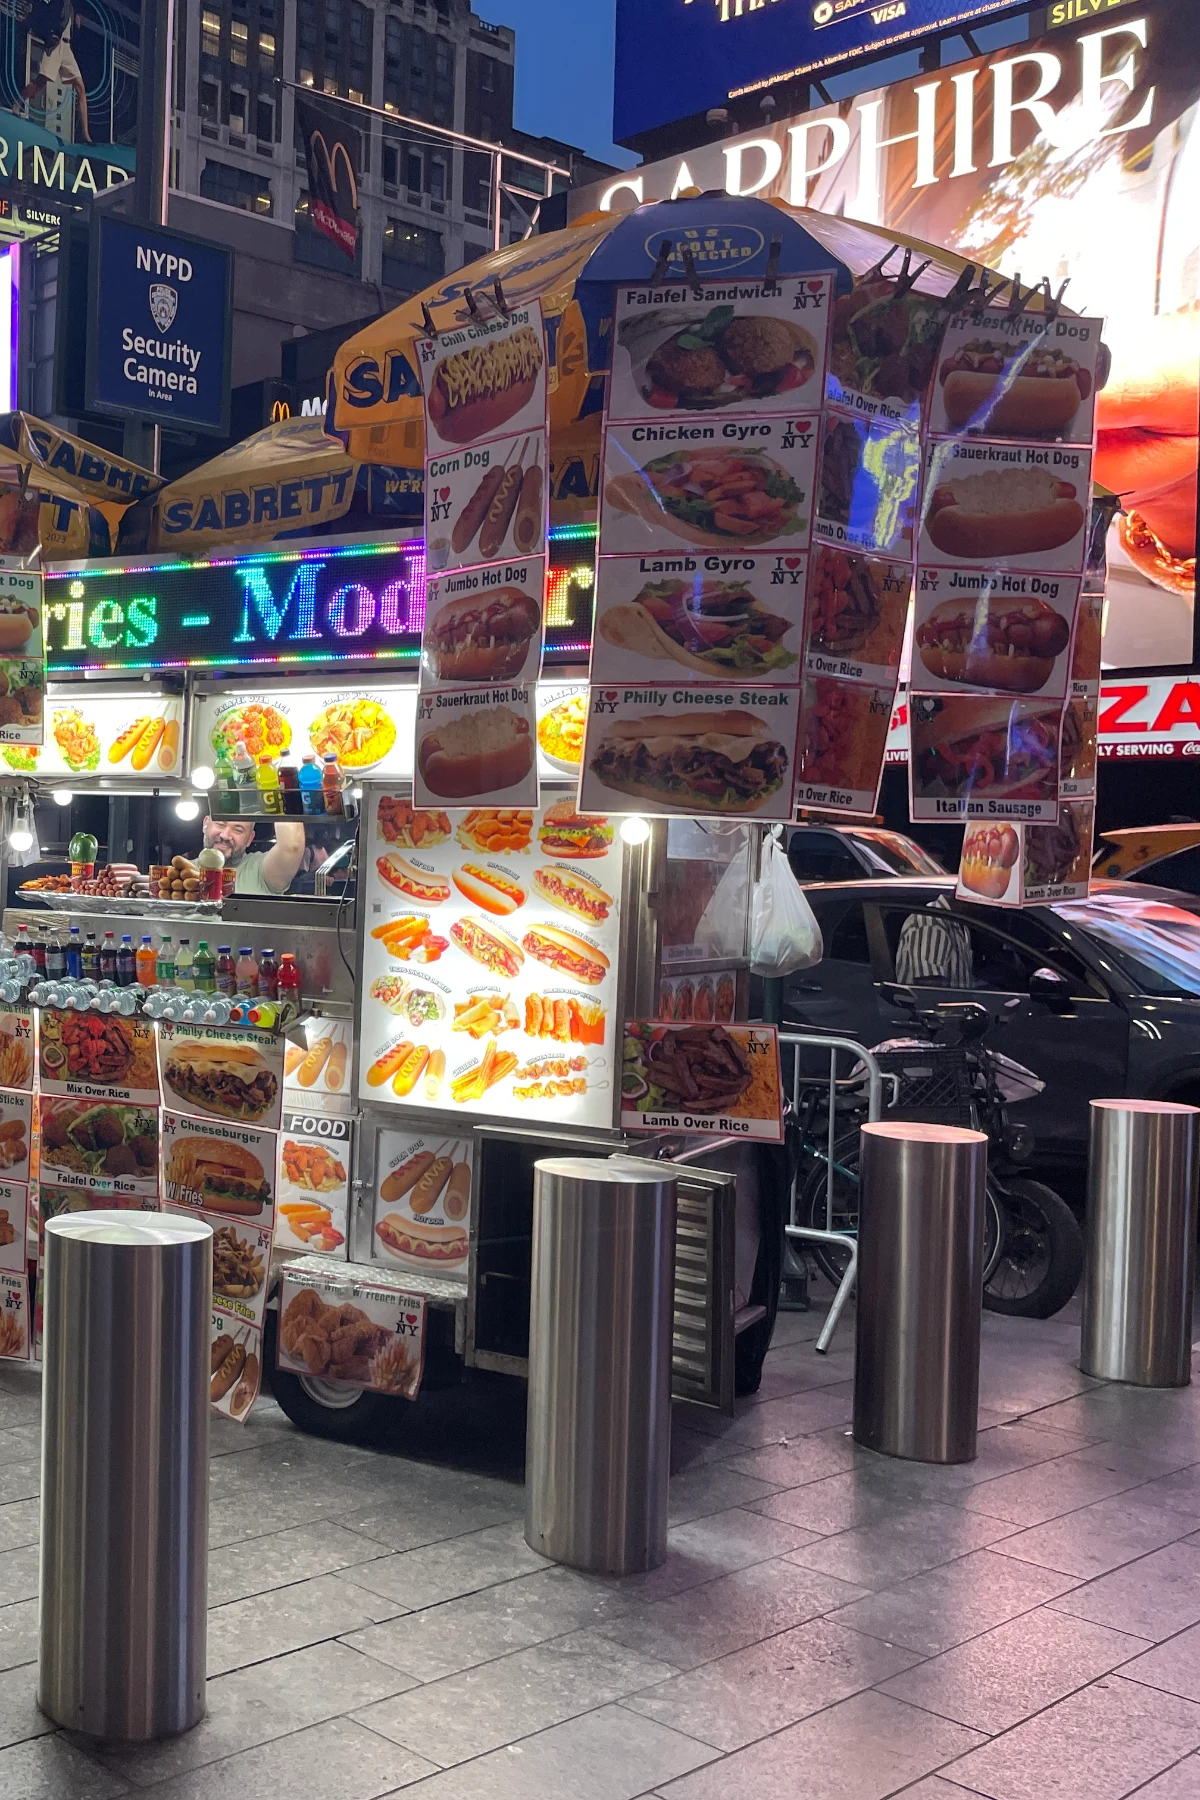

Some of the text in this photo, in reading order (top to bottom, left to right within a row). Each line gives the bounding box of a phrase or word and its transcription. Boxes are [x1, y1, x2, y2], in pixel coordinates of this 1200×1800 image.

[871, 2, 906, 25] VISA
[864, 39, 886, 52] Subject
[893, 32, 910, 42] credit
[939, 17, 957, 27] Learn
[957, 11, 974, 20] more
[136, 246, 193, 281] NYPD
[626, 283, 783, 305] Falafel Sandwich
[441, 310, 530, 349] Chili Cheese Dog
[1023, 316, 1050, 336] Hot
[1055, 323, 1090, 341] Dog
[122, 328, 201, 372] Security
[124, 358, 197, 394] Camera
[148, 388, 173, 401] In Area
[825, 386, 901, 422] alafel Over Rice
[631, 423, 772, 442] Chicken Gyro
[780, 434, 814, 449] NY
[430, 450, 490, 478] Corn Dog
[952, 444, 1079, 469] Sauerkraut Hot Dog
[162, 469, 354, 534] SABRETT
[45, 532, 67, 544] 2023
[639, 556, 756, 574] Lamb Gyro
[9, 576, 34, 590] Dog
[444, 566, 528, 594] Jumbo Hot Dog
[770, 570, 803, 585] NY
[949, 572, 1060, 598] Jumbo Hot Dog
[815, 658, 863, 678] Over Rice
[436, 688, 529, 708] Sauerkraut Hot Dog
[623, 691, 789, 707] Philly Cheese Steak
[0, 729, 21, 740] Rice
[1116, 743, 1174, 756] SERVING
[806, 787, 853, 805] Over Rice
[935, 799, 1042, 818] Italian Sausage
[176, 1024, 278, 1046] Philly Cheese Steak
[66, 1084, 130, 1099] Mix Over Rice
[180, 1120, 262, 1145] Cheeseburger
[289, 1115, 346, 1137] FOOD
[643, 1114, 750, 1132] Lamb Over Rice
[388, 1151, 409, 1168] CORN
[57, 1173, 136, 1192] Falafel Over Rice
[1, 1275, 22, 1289] Fries
[365, 1289, 396, 1307] French
[398, 1293, 421, 1310] Fries
